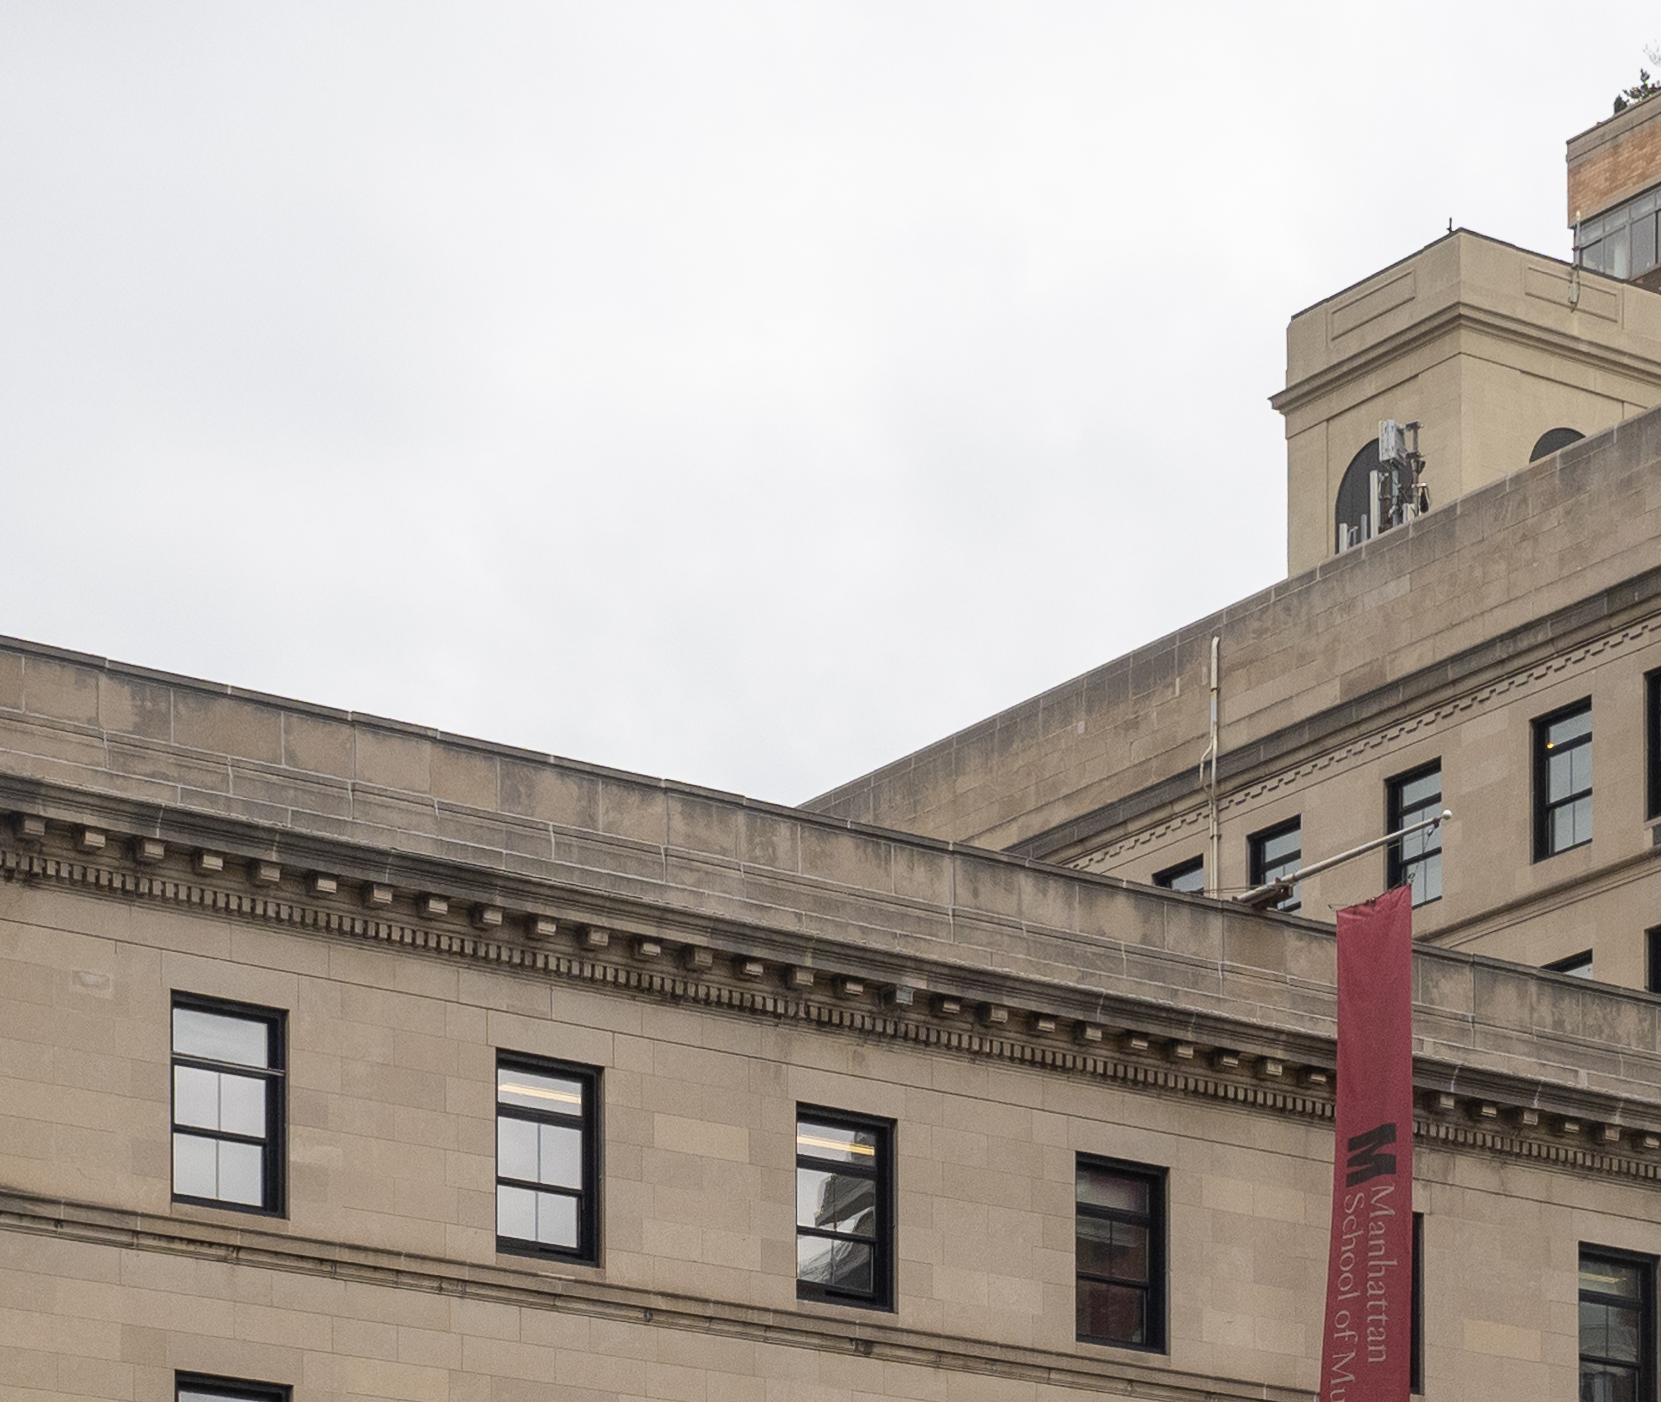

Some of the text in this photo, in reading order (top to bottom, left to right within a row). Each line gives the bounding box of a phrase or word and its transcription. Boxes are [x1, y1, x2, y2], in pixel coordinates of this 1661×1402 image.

[1337, 1192, 1366, 1301] School
[1366, 1184, 1399, 1364] Manhattan
[1334, 1309, 1358, 1344] of
